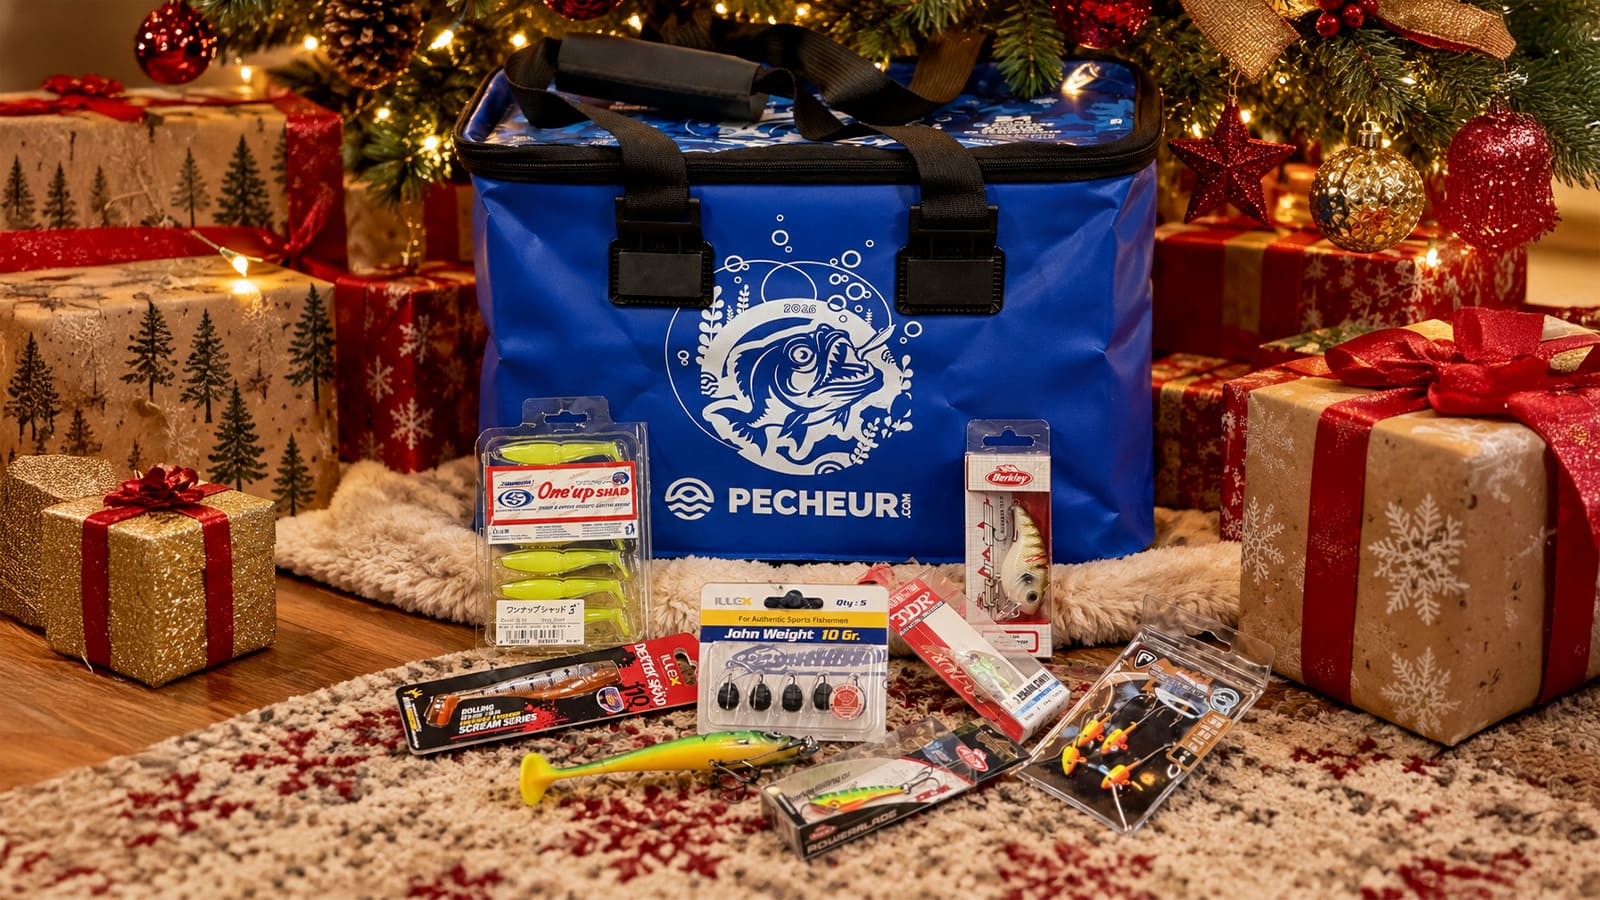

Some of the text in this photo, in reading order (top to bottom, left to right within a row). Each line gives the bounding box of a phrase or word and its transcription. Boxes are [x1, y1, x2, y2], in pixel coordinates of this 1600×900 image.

[783, 303, 817, 314] 2026
[992, 473, 1029, 485] Berkley
[596, 487, 630, 498] SHAD
[728, 487, 911, 519] PECHEUR .COM
[836, 599, 852, 607] Qty
[787, 617, 811, 625] Sports
[724, 628, 861, 642] John Weight 10 Gr.
[458, 719, 502, 734] SCREAM
[503, 713, 537, 729] SERIES
